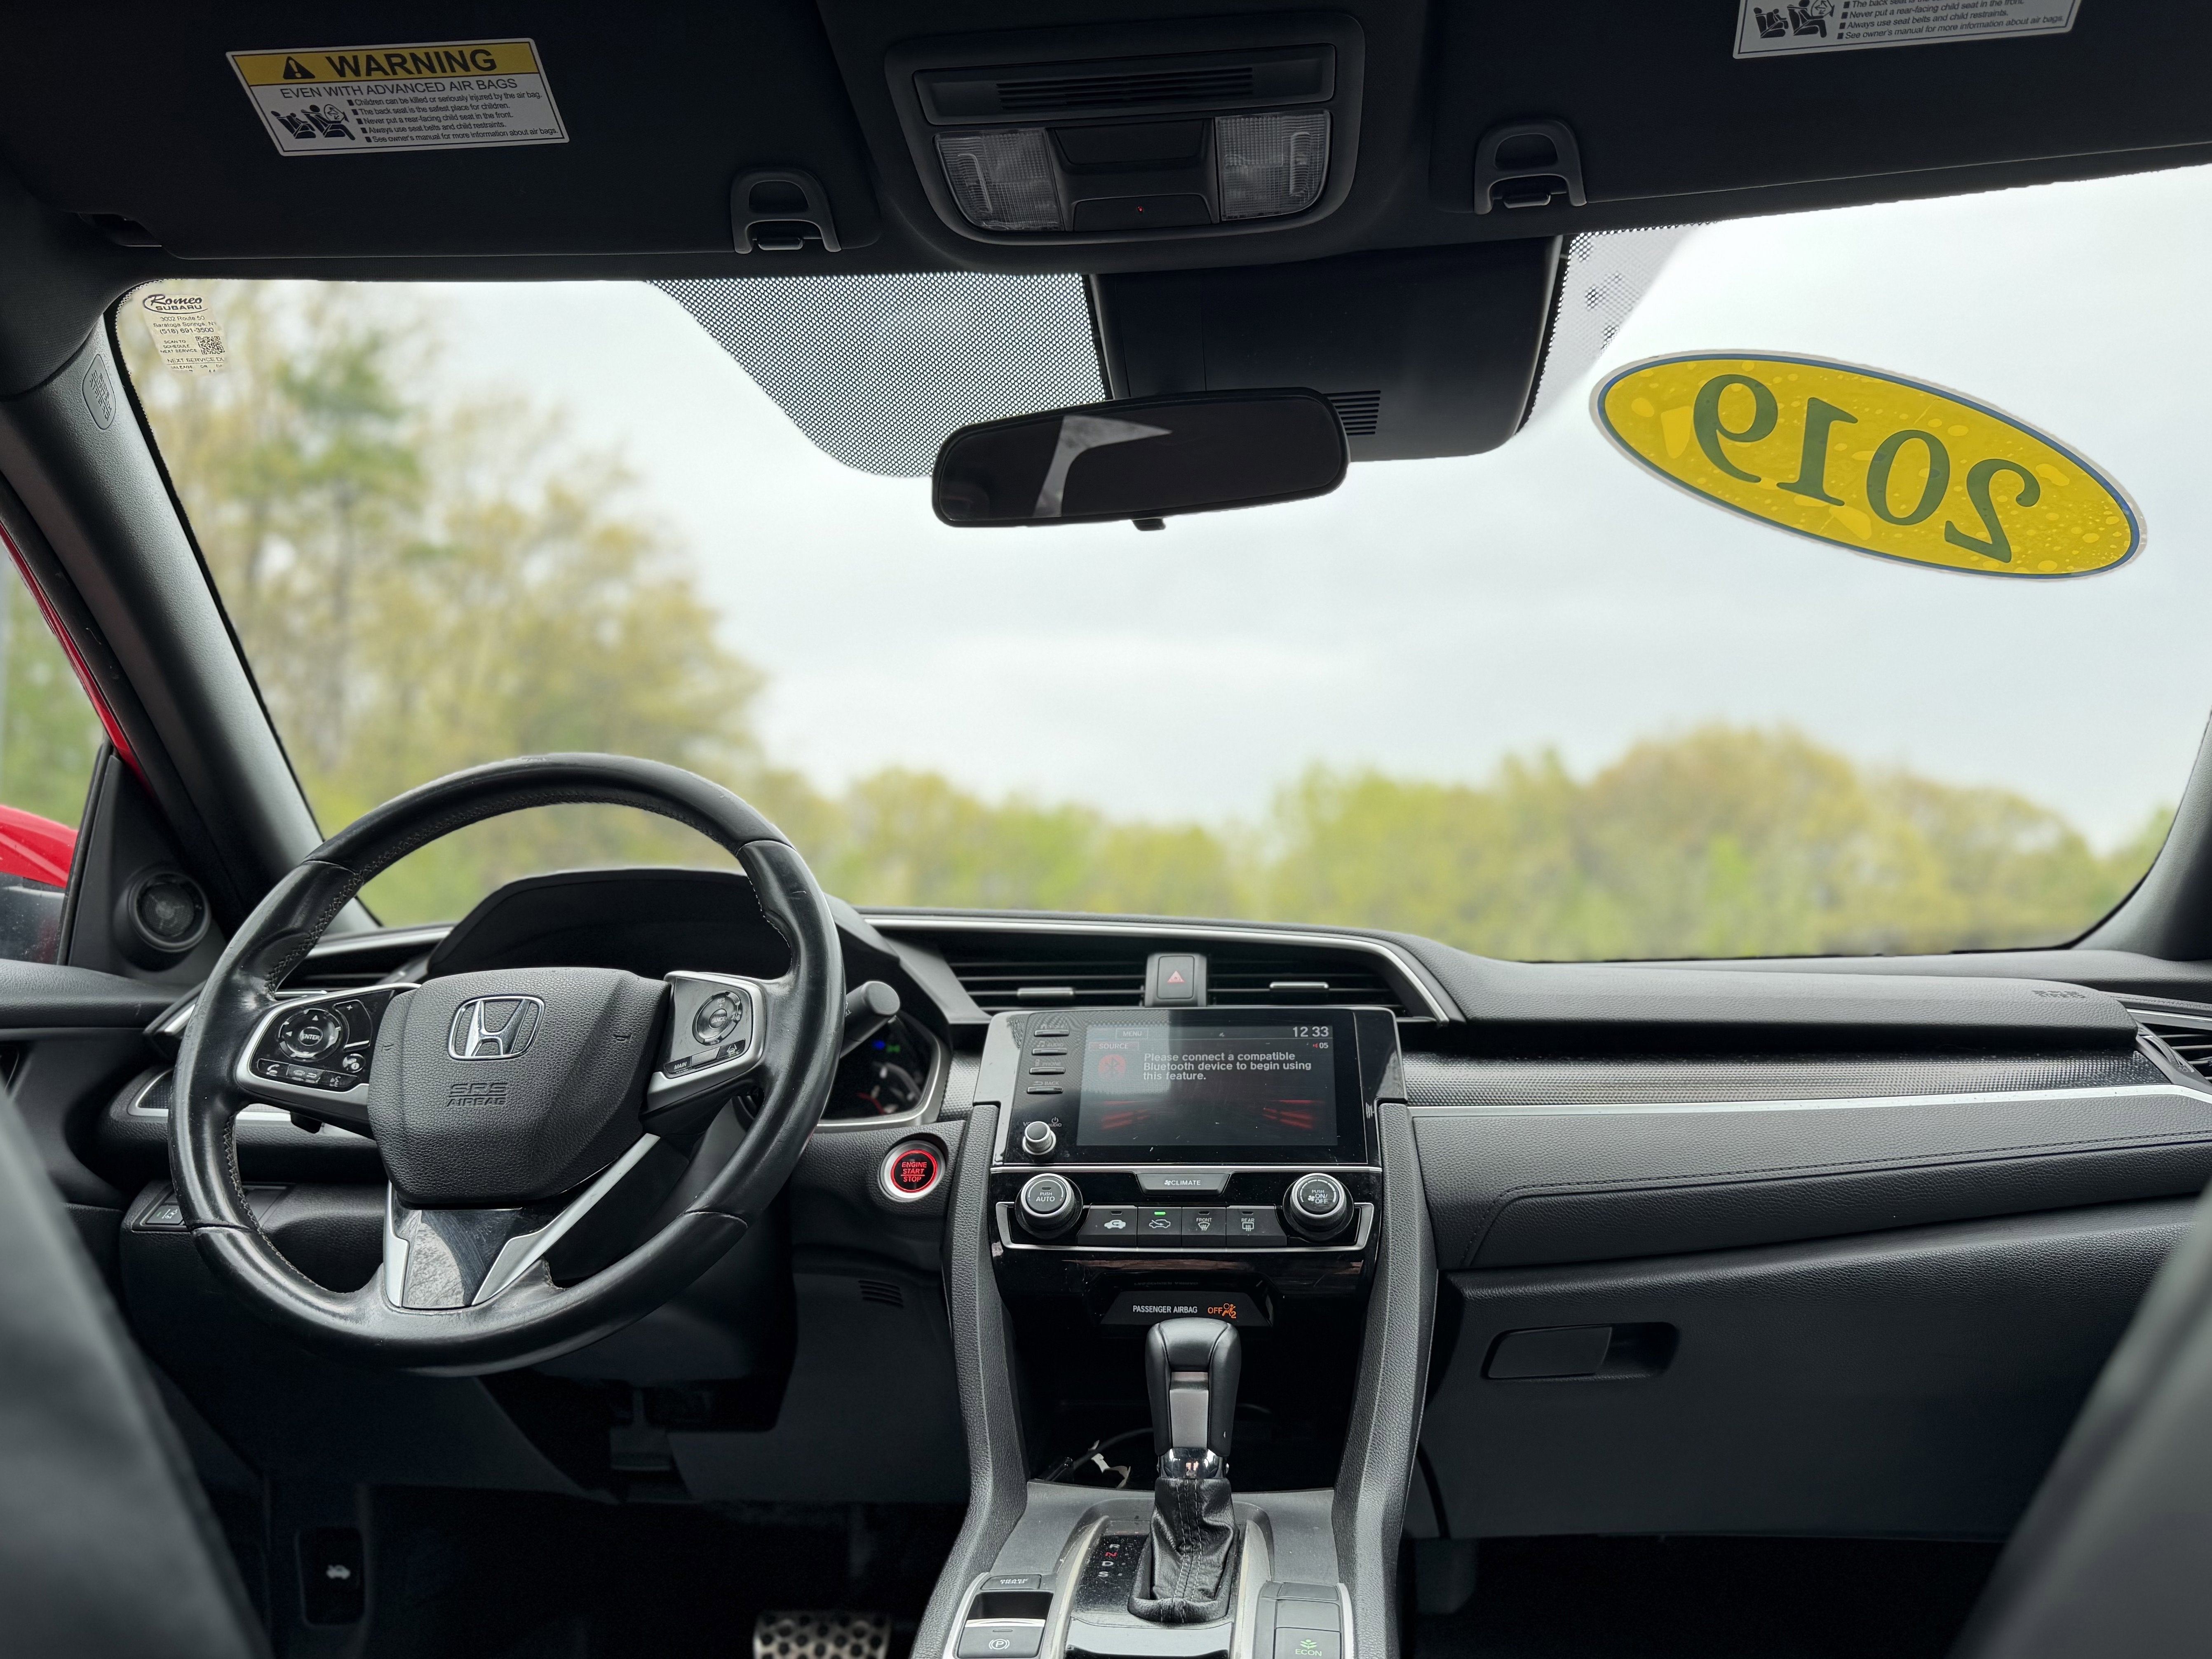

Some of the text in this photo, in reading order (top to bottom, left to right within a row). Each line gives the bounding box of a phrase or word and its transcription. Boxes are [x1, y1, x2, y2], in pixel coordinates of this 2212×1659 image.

[1874, 9, 1888, 17] put
[1897, 5, 1939, 14] rear-facing
[1941, 2, 1959, 11] child
[1847, 21, 1875, 29] Always
[1950, 12, 1968, 20] child
[1970, 9, 2008, 19] restraints.
[1862, 29, 1892, 38] owner's
[1895, 26, 1923, 35] manual
[1960, 20, 2003, 29] information
[2005, 17, 2028, 26] about
[325, 49, 497, 77] WARNING
[280, 78, 518, 98] EVEN WITH ADVANCED AIR BAGS
[470, 93, 493, 102] injured
[148, 294, 202, 306] Romeo
[1144, 1053, 1179, 1061] Please
[1182, 1052, 1225, 1061] connect
[1237, 1052, 1296, 1061] compatible
[674, 1061, 687, 1070] MAIN
[1143, 1061, 1311, 1070] Bluetooth device to begin using
[1143, 1071, 1206, 1080] this feature.
[447, 1097, 506, 1107] AIRBAG
[1133, 1305, 1172, 1313] PASSENGER
[1173, 1305, 1198, 1314] AIRBAG
